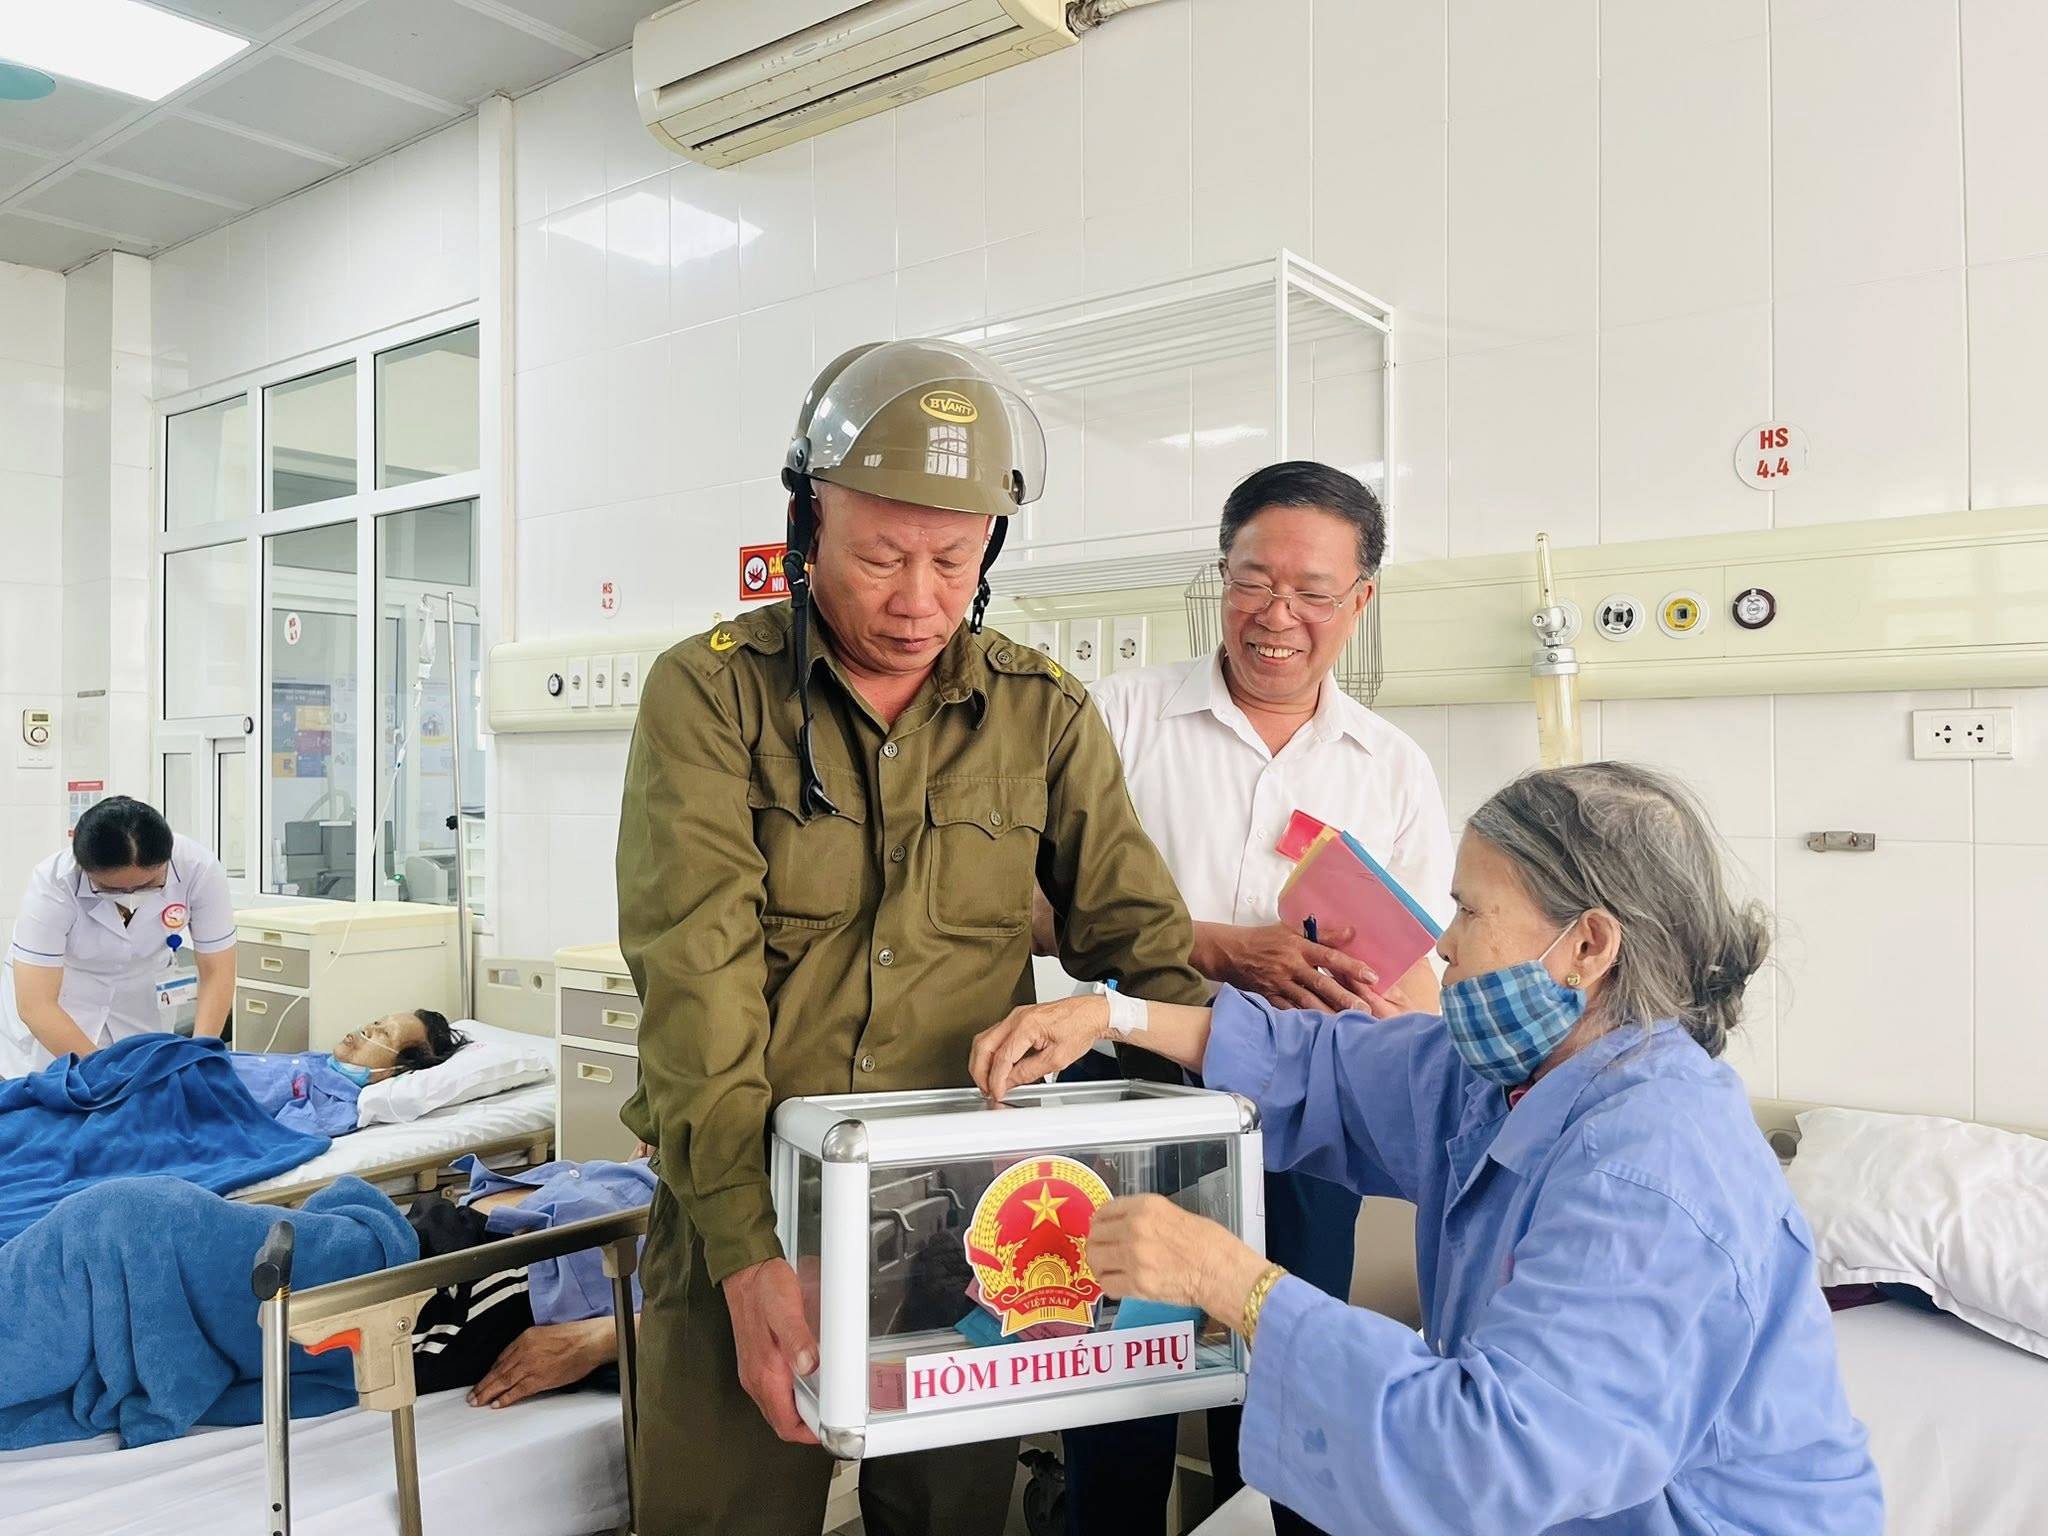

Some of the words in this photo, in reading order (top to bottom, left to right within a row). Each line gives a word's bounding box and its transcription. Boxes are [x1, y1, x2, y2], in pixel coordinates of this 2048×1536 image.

[1759, 427, 1789, 450] HS
[1756, 456, 1790, 479] 4.4
[602, 582, 613, 594] HS
[771, 577, 785, 593] NO
[1023, 1295, 1047, 1309] VIỆT
[1048, 1296, 1071, 1307] NAM
[912, 1356, 999, 1399] HÒM
[1010, 1339, 1114, 1386] PHIẾU
[1124, 1333, 1191, 1371] PHỤ
